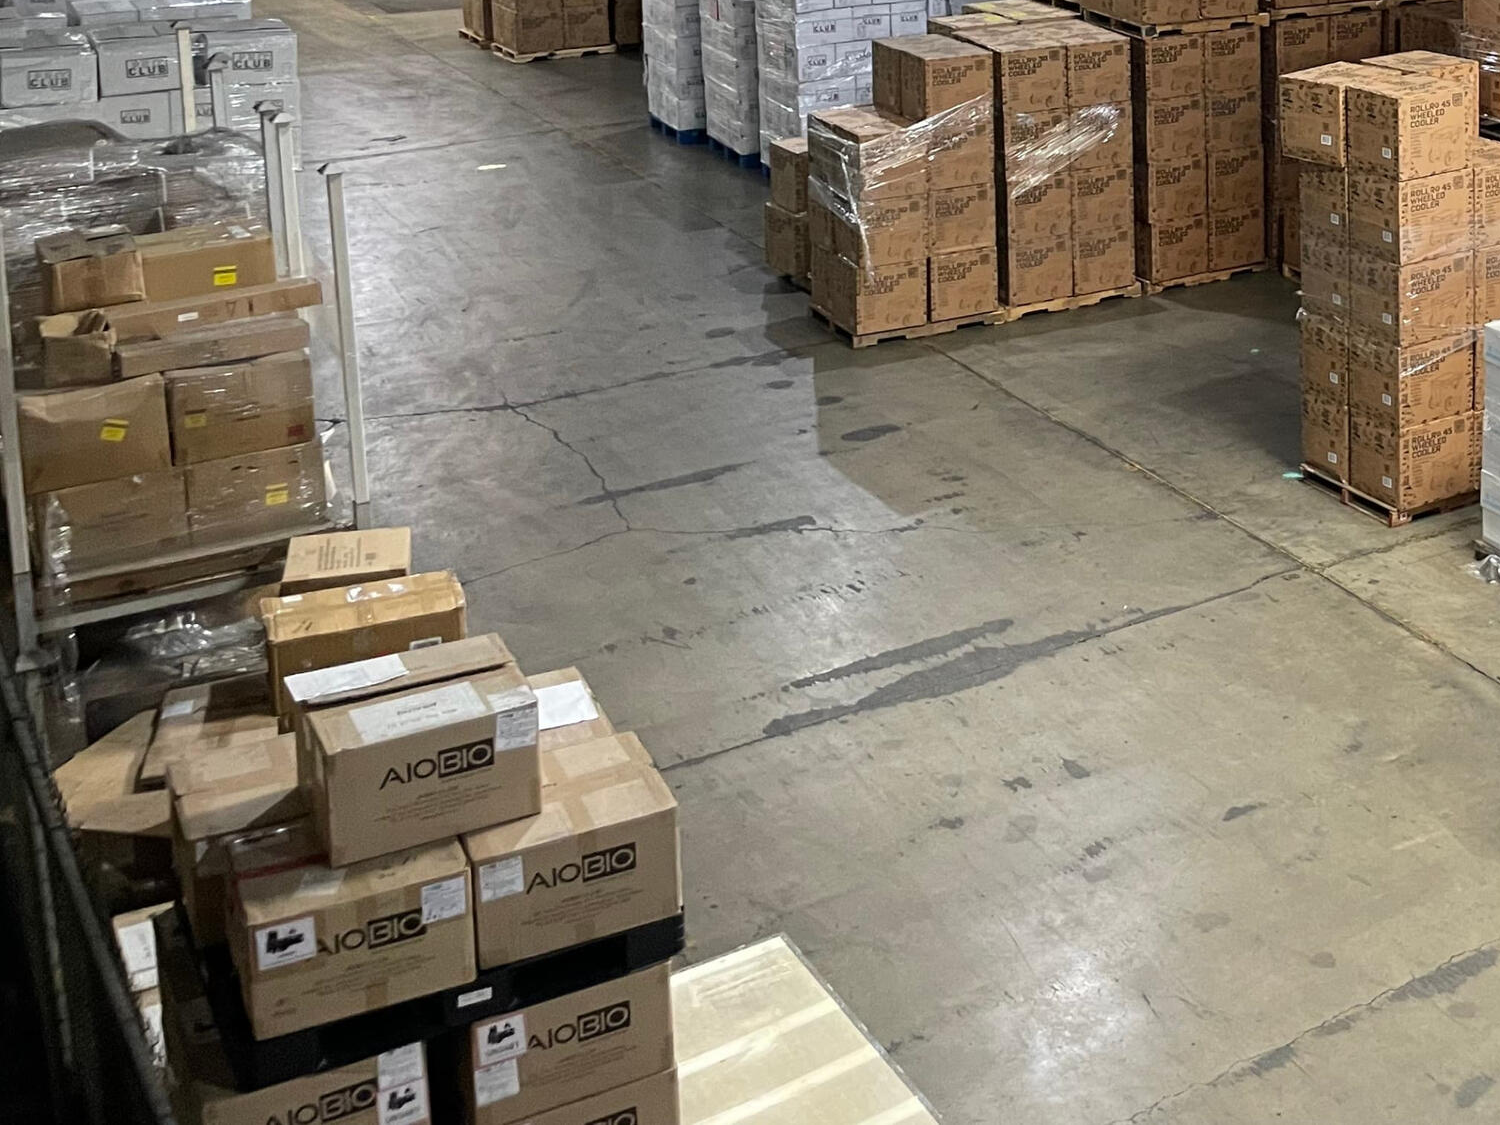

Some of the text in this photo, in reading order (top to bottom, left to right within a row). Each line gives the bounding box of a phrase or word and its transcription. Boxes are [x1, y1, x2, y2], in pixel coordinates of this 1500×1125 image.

[1410, 109, 1445, 121] WHEELED
[1410, 117, 1439, 128] COOLER
[1442, 183, 1452, 191] 45
[1411, 191, 1445, 205] WHEELED
[1411, 201, 1440, 212] COOLER
